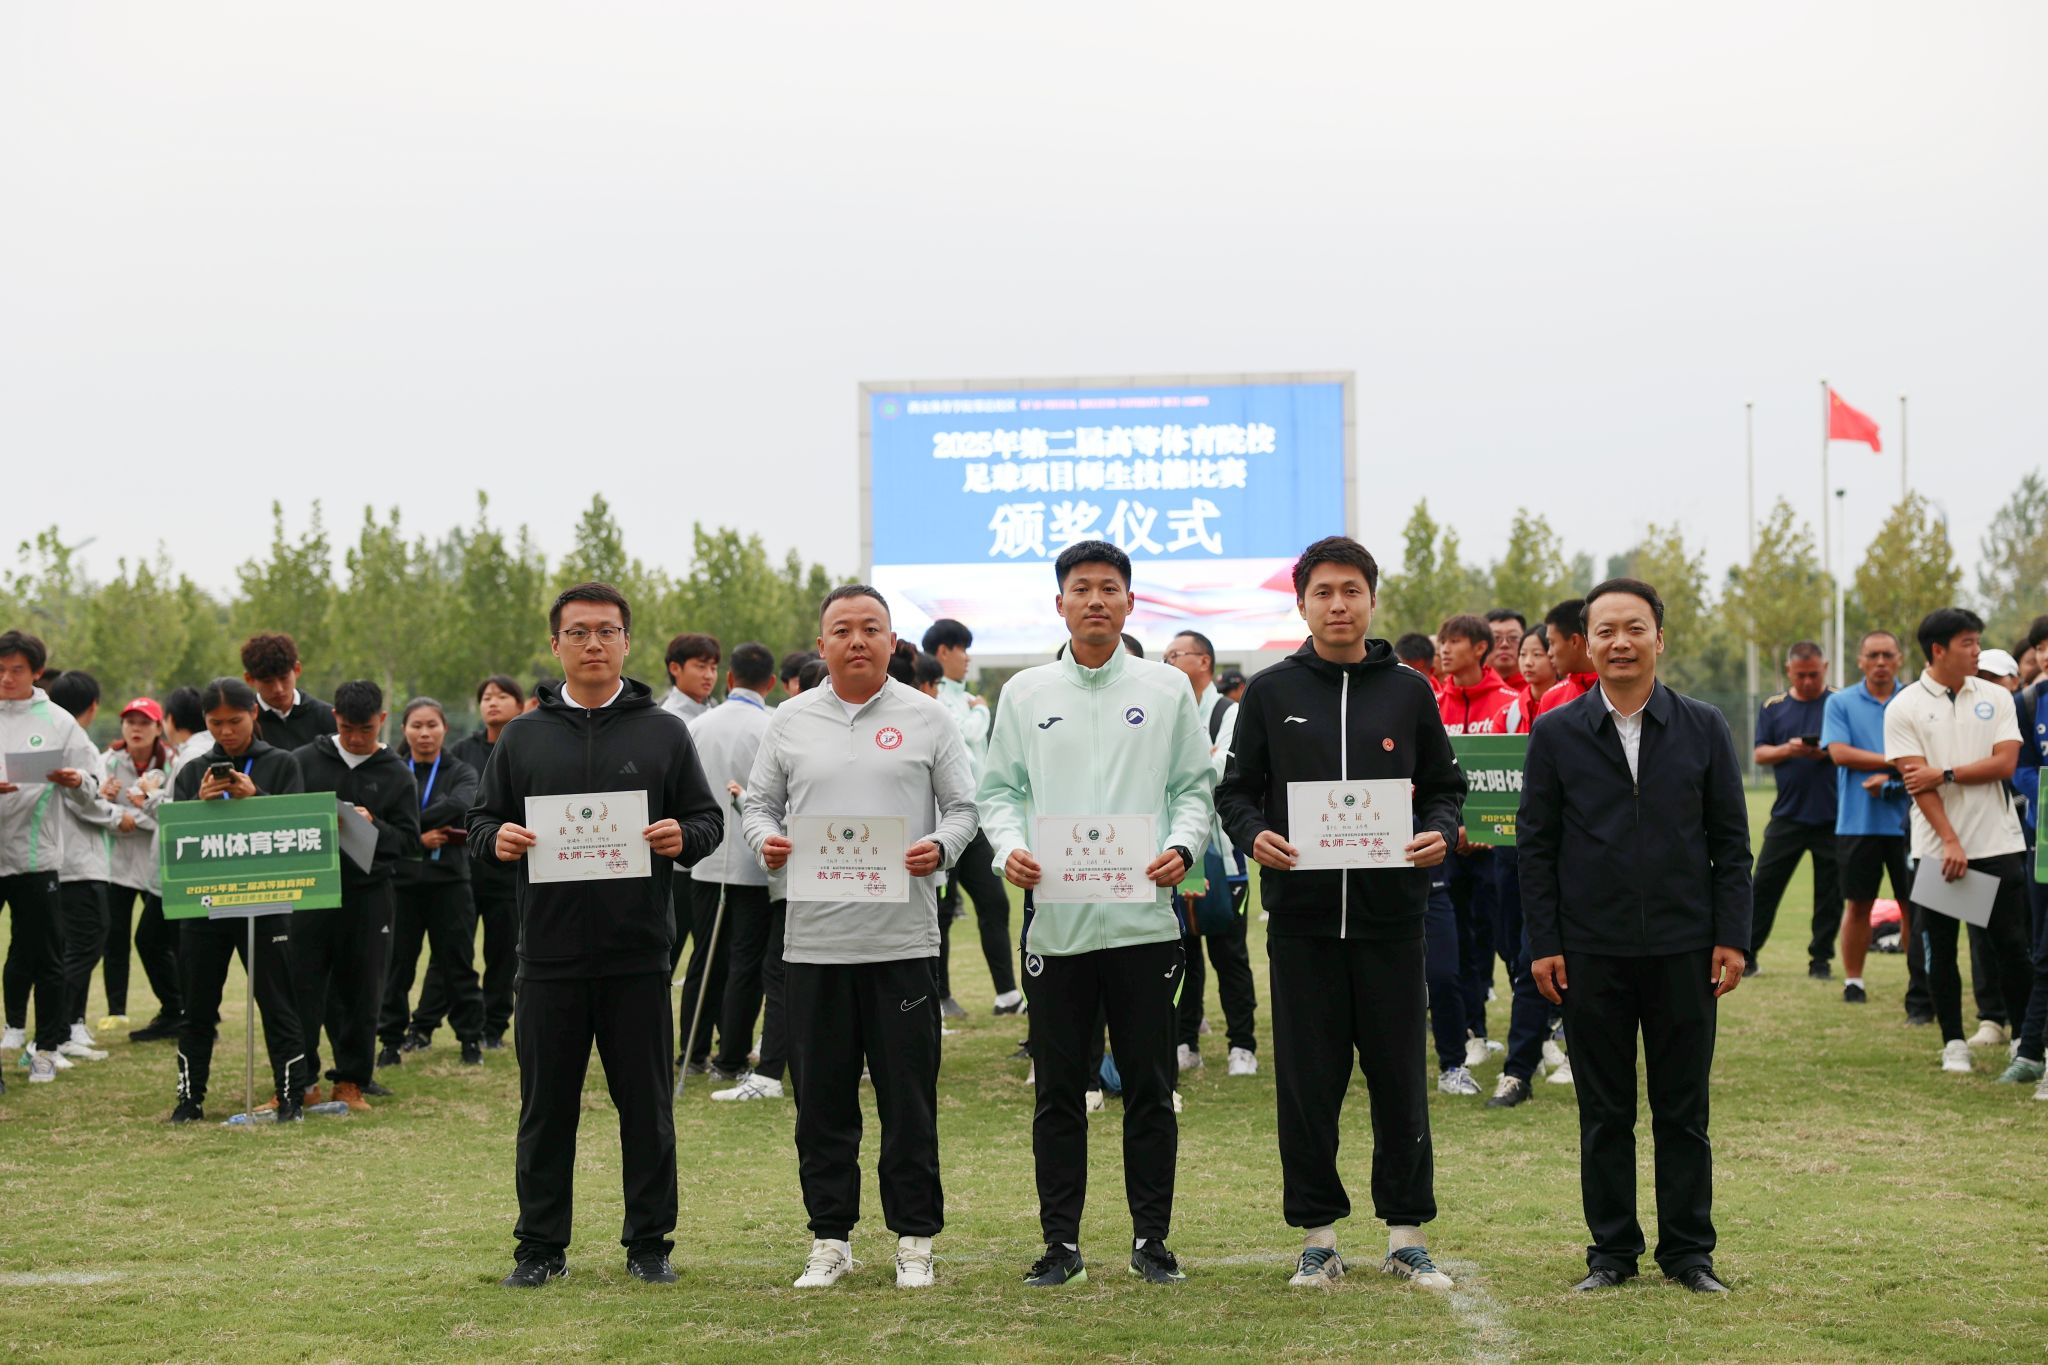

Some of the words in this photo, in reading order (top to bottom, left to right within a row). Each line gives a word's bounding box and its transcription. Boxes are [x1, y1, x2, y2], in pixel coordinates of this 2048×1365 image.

[933, 423, 1277, 460] 2025年第二届高等体育院校
[963, 459, 1247, 494] 足球项目师生技能比赛
[989, 497, 1224, 559] 颁奖仪式
[1321, 811, 1380, 822] 获奖证书
[559, 823, 618, 836] 获奖证书
[175, 827, 322, 861] 广州体育学院
[1319, 837, 1384, 848] 教师二等奖
[557, 848, 622, 861] 教师二等奖
[820, 845, 878, 855] 获奖证书
[1065, 846, 1124, 856] 获奖证书
[816, 871, 881, 881] 教师二等奖
[1062, 872, 1127, 882] 教师二等奖
